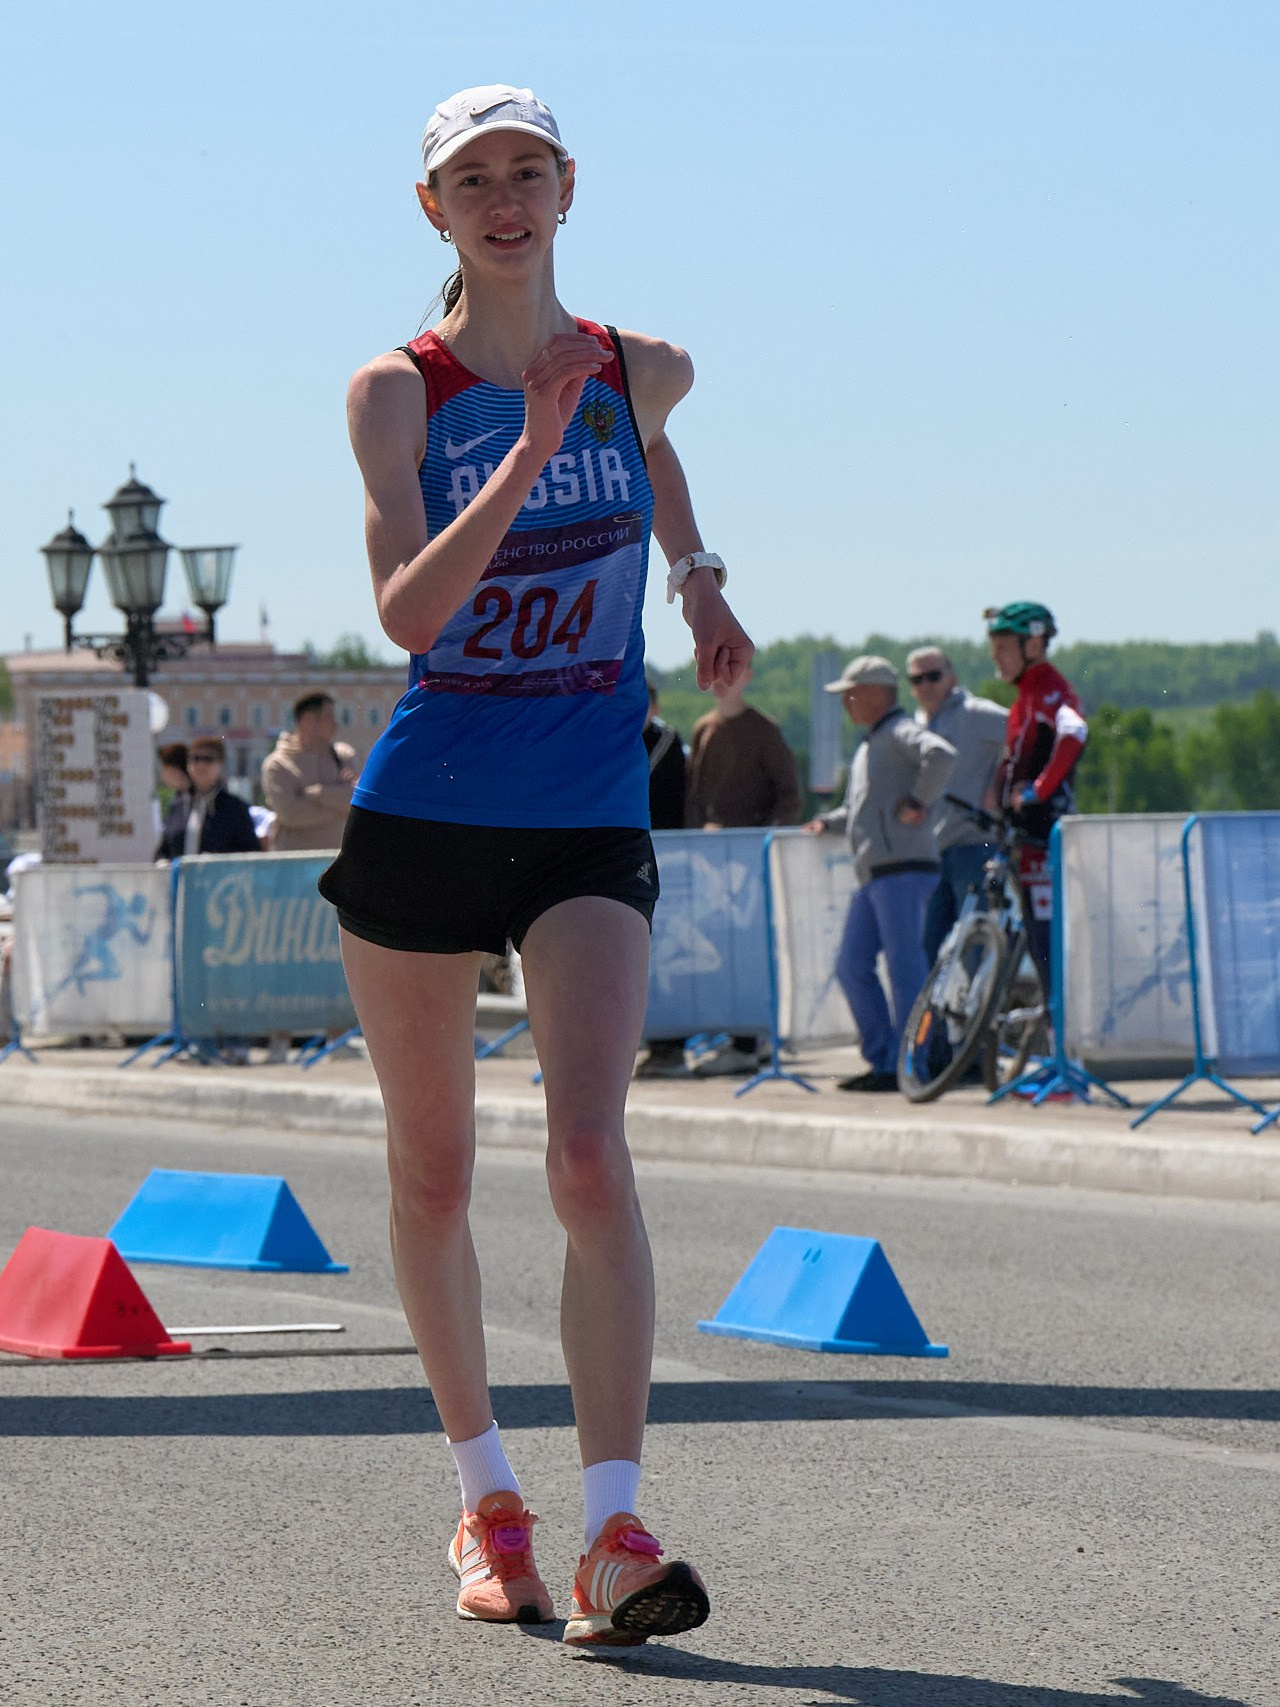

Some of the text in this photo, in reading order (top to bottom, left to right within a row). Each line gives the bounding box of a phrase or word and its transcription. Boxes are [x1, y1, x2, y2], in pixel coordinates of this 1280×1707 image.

[494, 526, 630, 561] ЕНСТВО РОССИИ
[463, 579, 599, 660] 204
[204, 870, 343, 967] Дина
